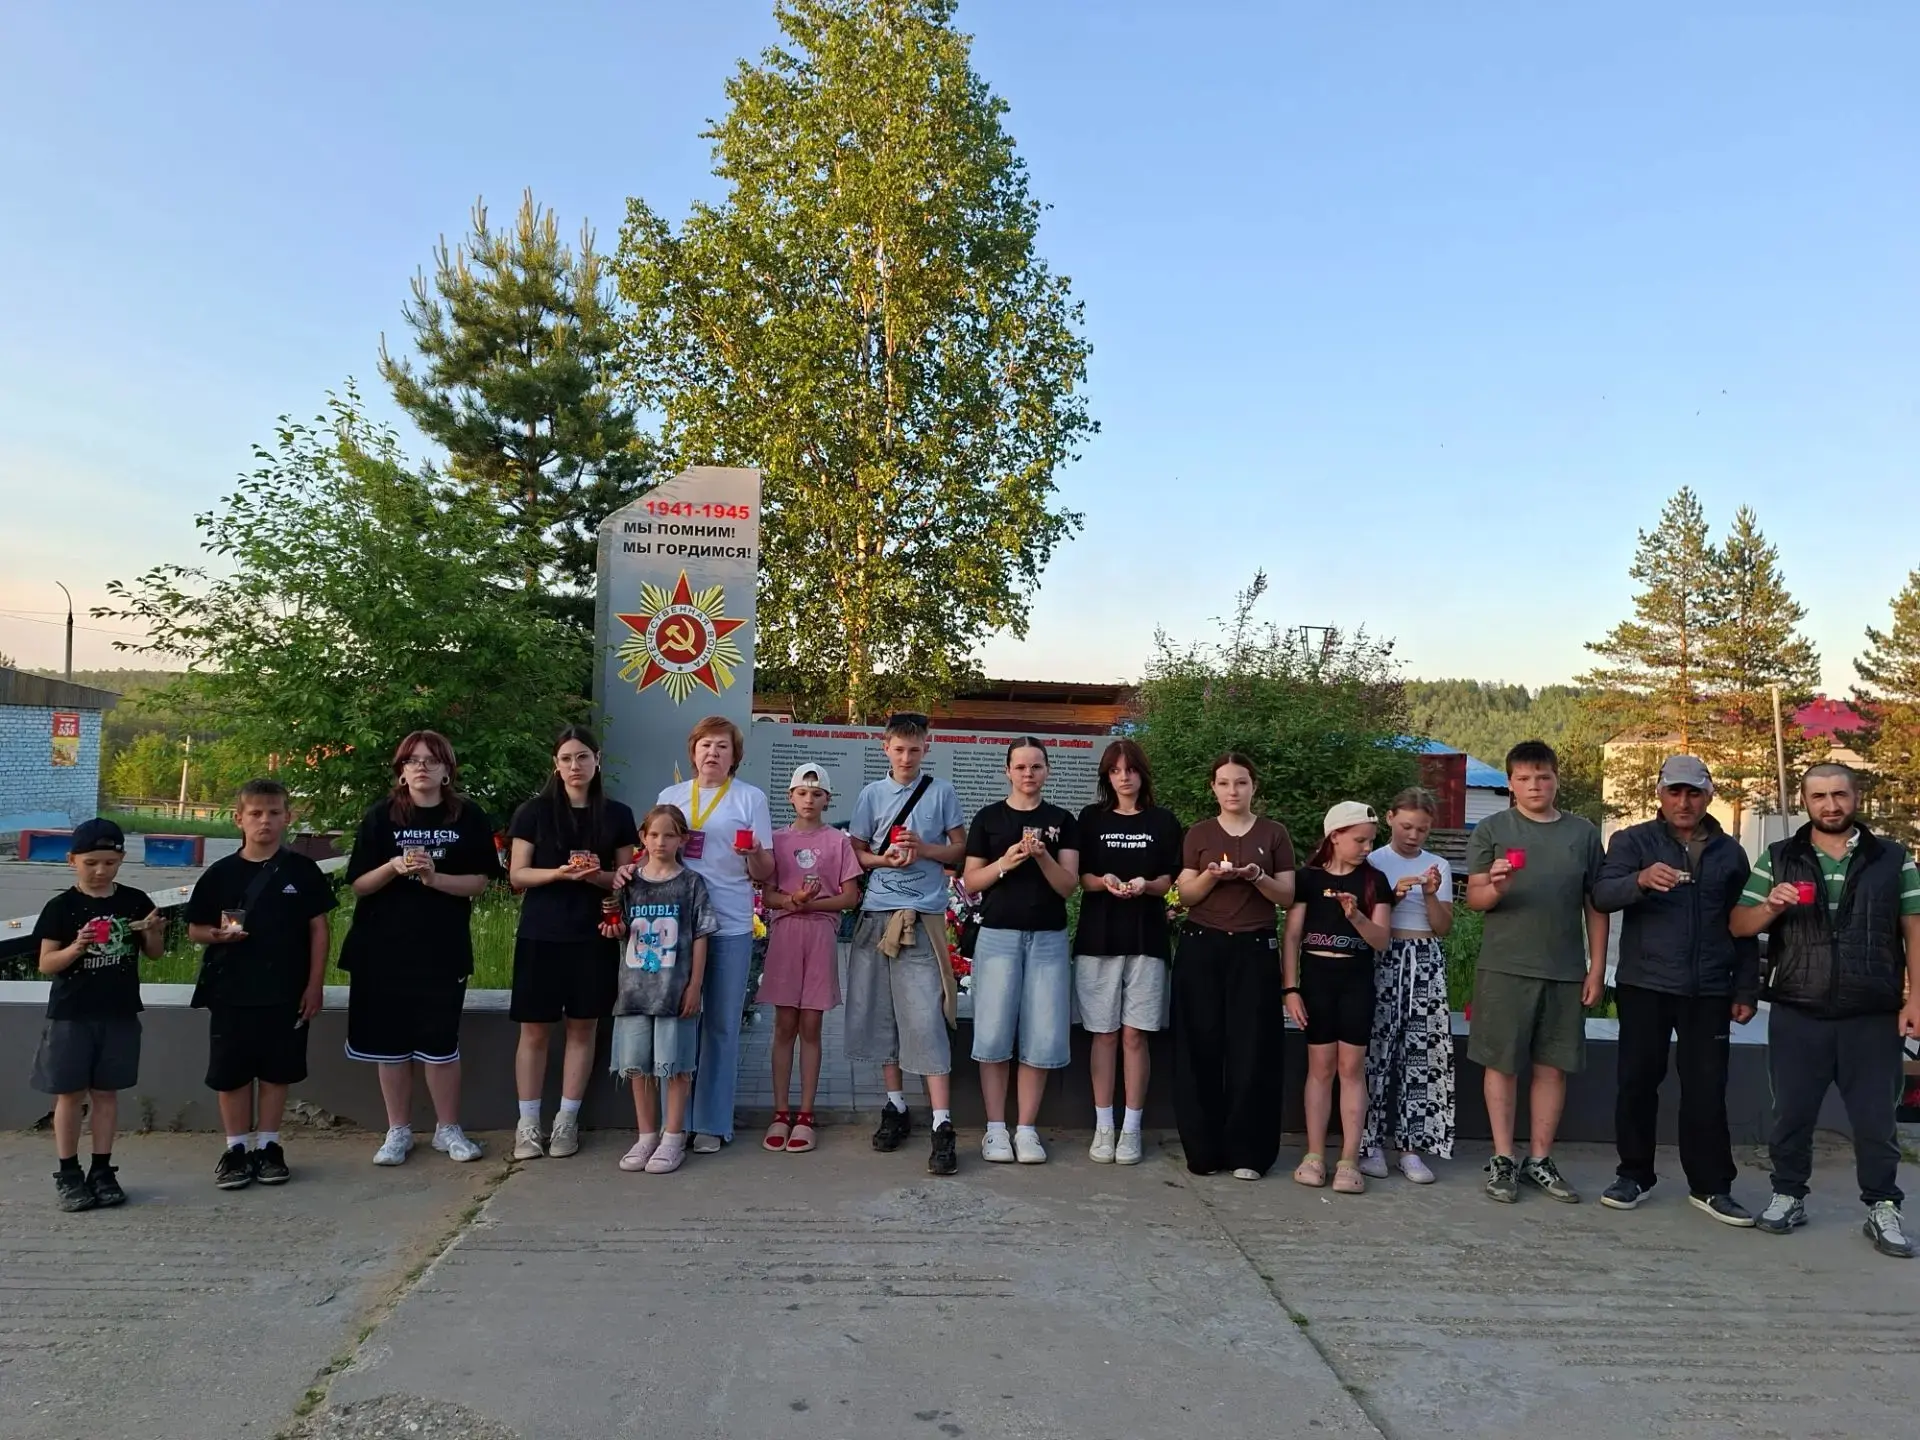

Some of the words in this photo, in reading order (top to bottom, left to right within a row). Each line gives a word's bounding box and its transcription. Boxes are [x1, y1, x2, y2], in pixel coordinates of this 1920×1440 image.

[646, 501, 750, 520] 1941-1945
[624, 522, 652, 534] МЫ
[657, 523, 736, 538] ПОМНИМ!
[623, 542, 651, 554] МЫ
[656, 543, 752, 559] ГОРДИМСЯ!
[647, 606, 710, 666] ОТЕЧЕСТВЕННАЯ
[393, 830, 401, 839] У
[403, 829, 431, 839] МЕНЯ
[433, 830, 460, 839] ЕСТЬ
[83, 955, 121, 969] RIDER
